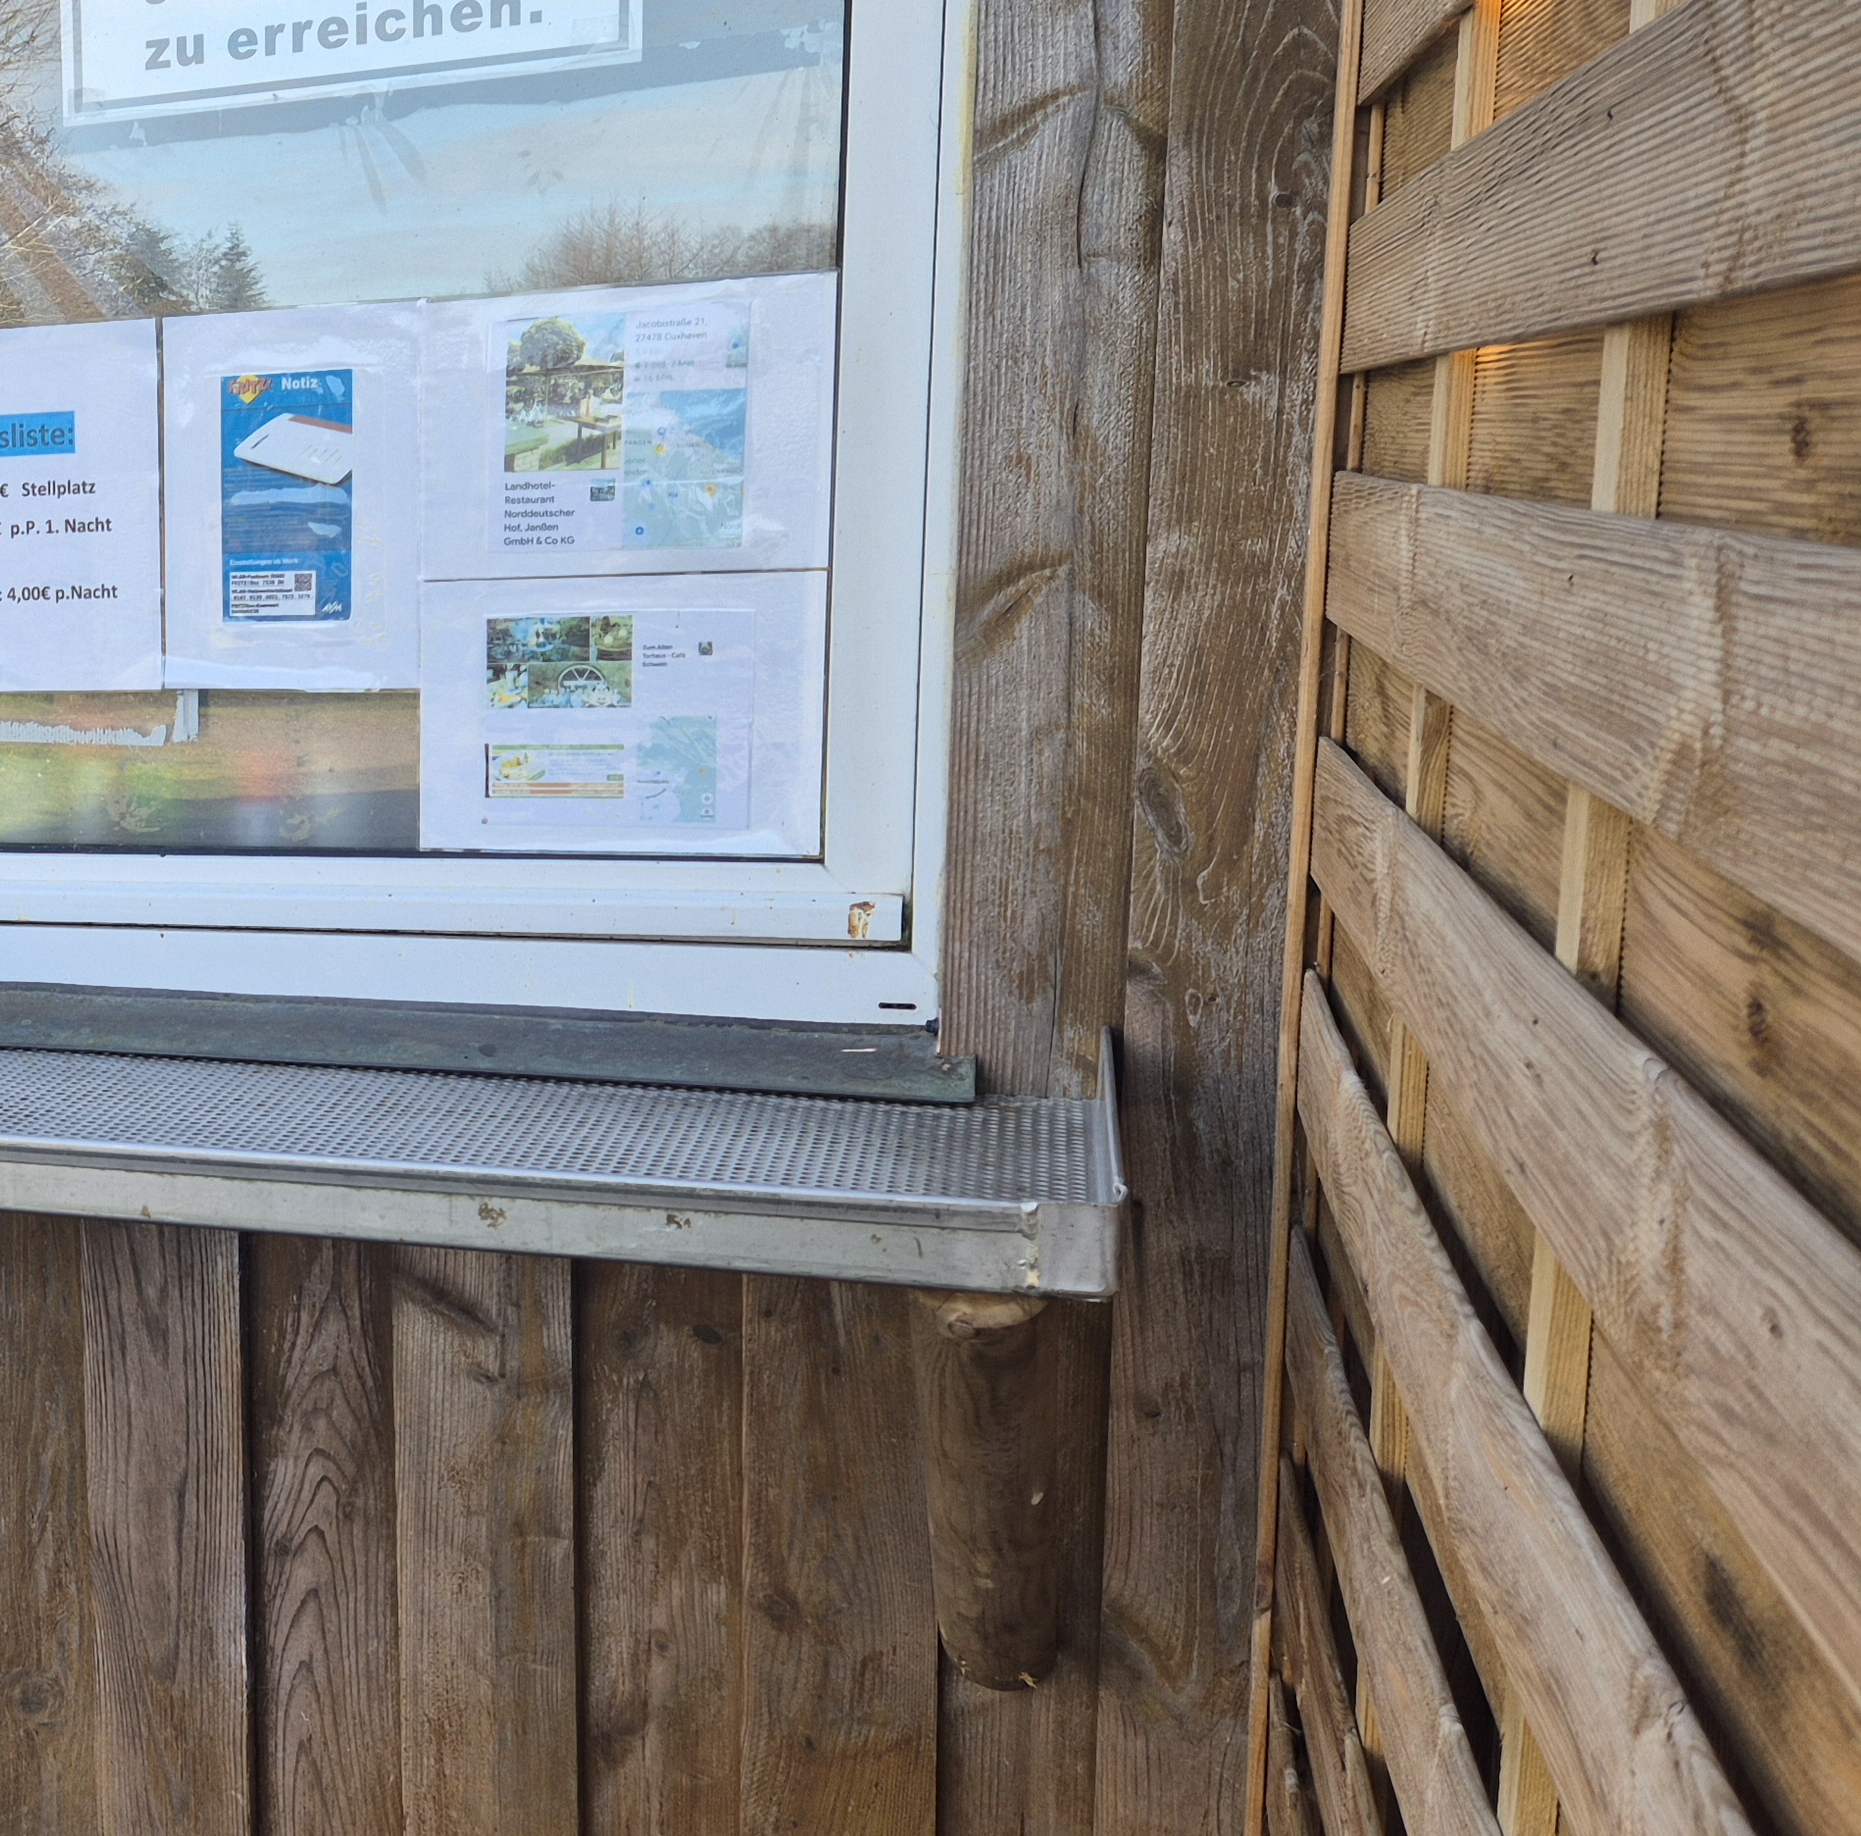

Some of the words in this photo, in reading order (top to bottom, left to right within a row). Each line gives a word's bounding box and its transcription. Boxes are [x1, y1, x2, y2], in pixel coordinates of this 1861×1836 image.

[144, 33, 205, 71] zu
[227, 0, 543, 61] erreichen.
[635, 333, 662, 343] 27478
[664, 331, 707, 341] Cuxhaven
[281, 375, 318, 391] Notiz
[21, 479, 96, 499] Stellplatz
[504, 481, 556, 491] Landhotel-
[504, 495, 555, 505] Restaurant
[504, 508, 576, 519] Norddeutscher
[10, 520, 40, 539] p.P.
[45, 519, 59, 534] 1.
[64, 516, 113, 534] Nacht
[524, 522, 559, 532] Janßen
[503, 536, 534, 546] GmbH
[544, 536, 559, 545] Co
[560, 535, 575, 545] KG
[6, 586, 51, 604] 4,00€
[55, 583, 118, 604] p.Nacht
